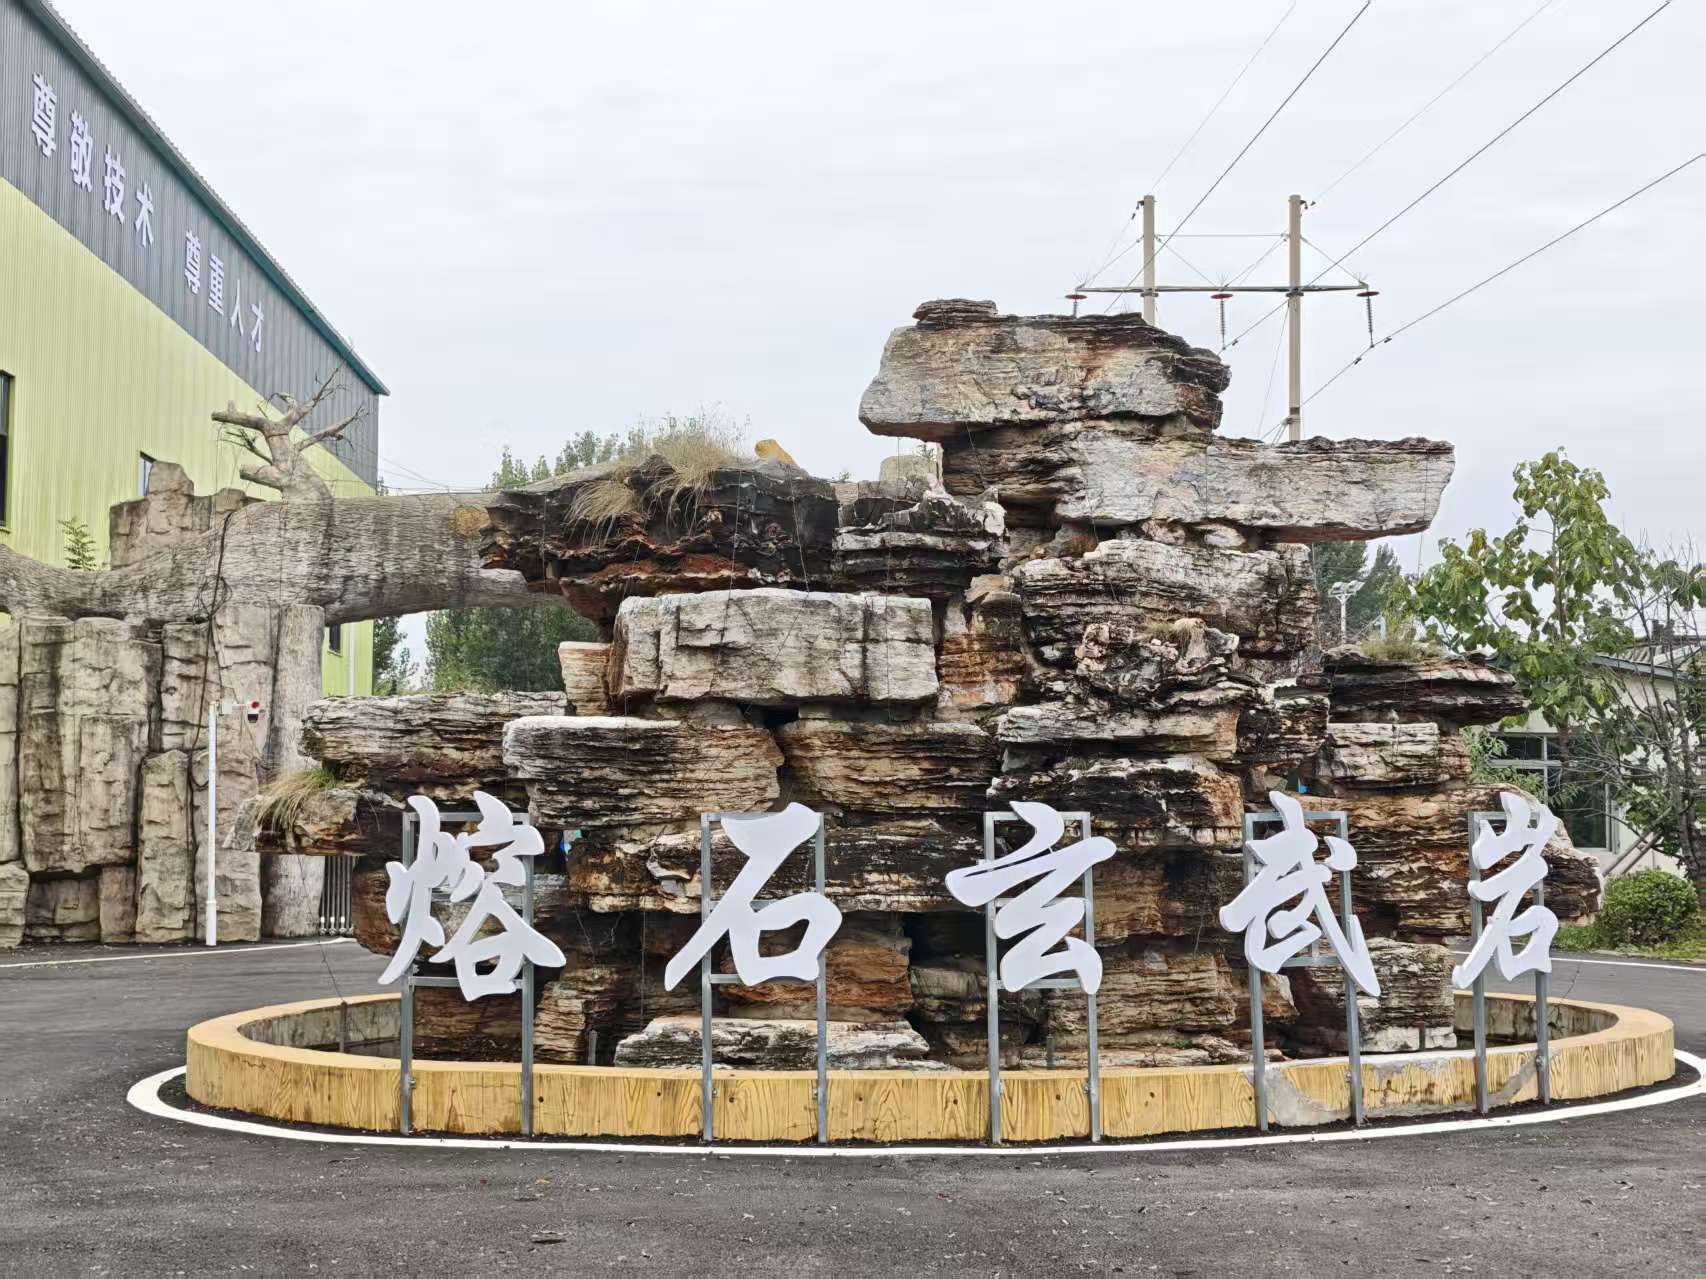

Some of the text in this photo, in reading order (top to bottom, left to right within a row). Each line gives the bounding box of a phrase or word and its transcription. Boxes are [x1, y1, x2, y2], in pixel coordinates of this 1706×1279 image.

[31, 72, 265, 352] 尊敬技术 尊重人才
